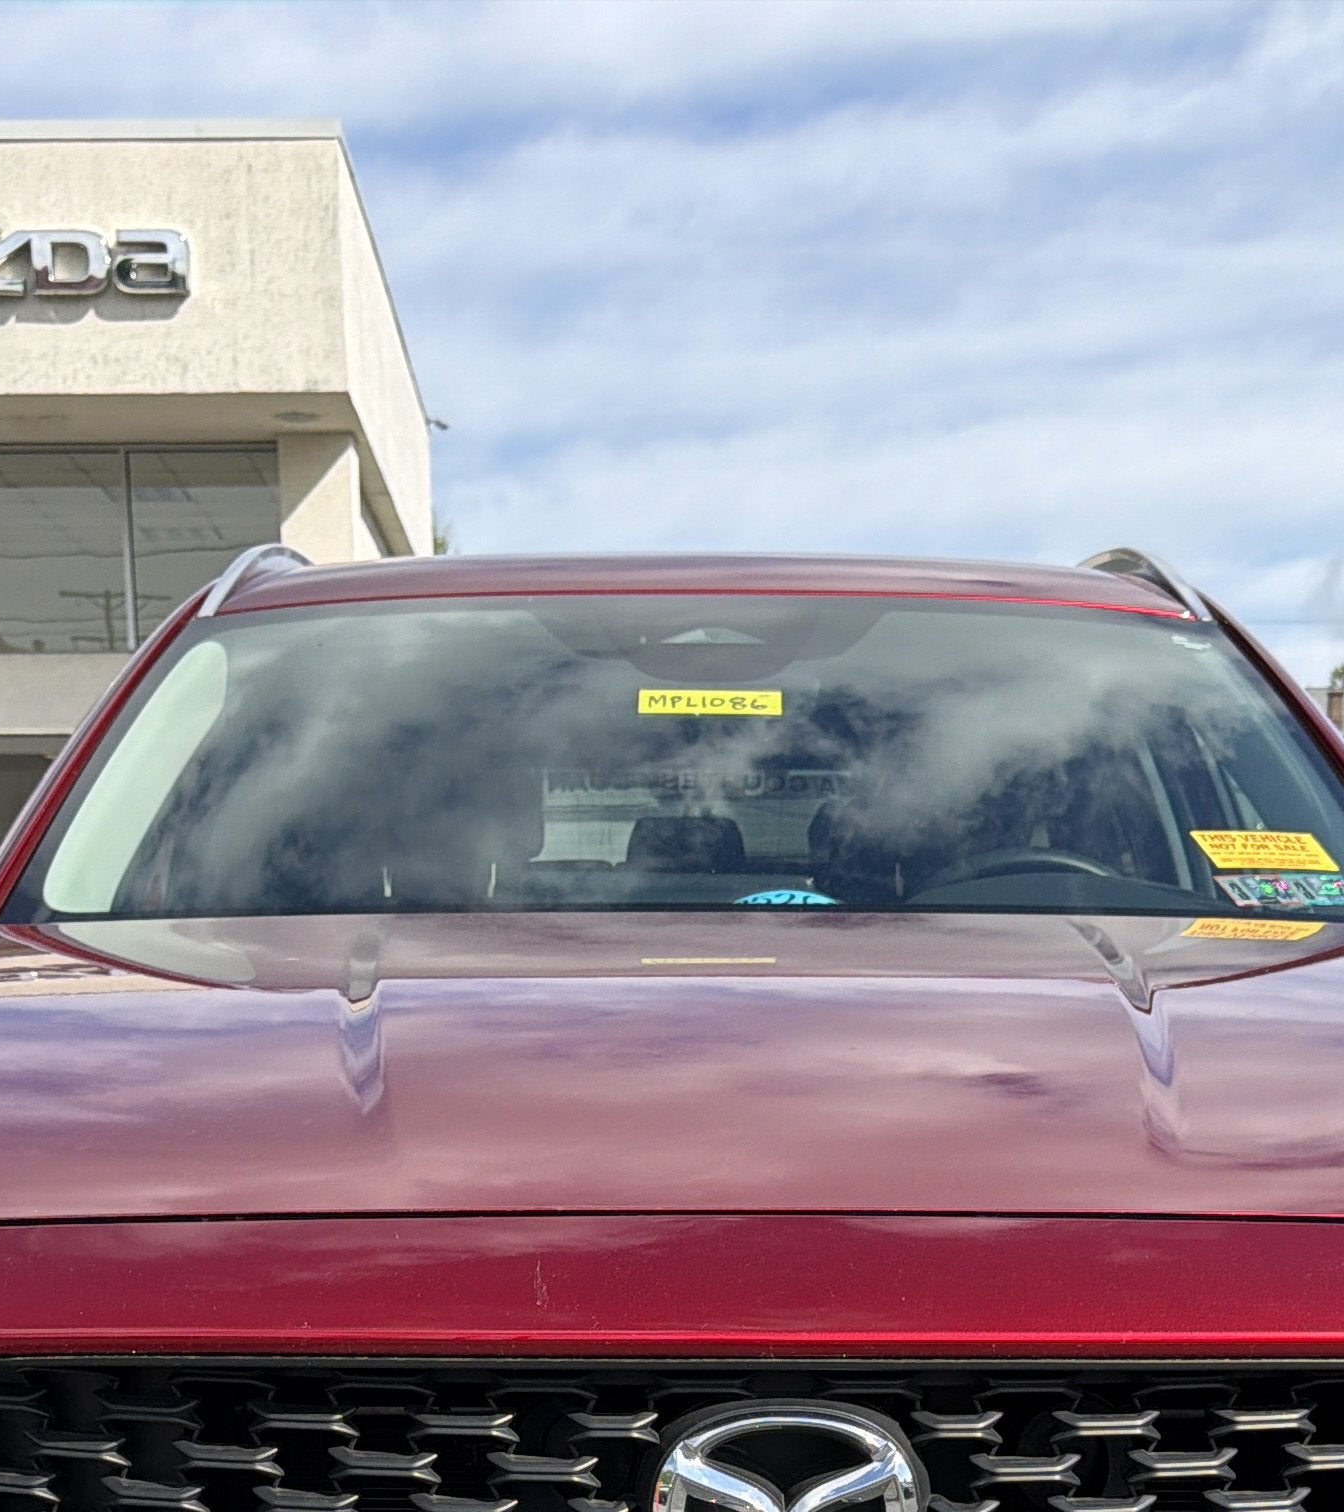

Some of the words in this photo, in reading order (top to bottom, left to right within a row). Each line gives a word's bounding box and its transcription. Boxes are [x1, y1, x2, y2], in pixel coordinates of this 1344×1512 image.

[1197, 833, 1237, 843] THIS
[1237, 834, 1308, 845] VEHICLE
[1208, 843, 1237, 851] NOT
[1240, 843, 1269, 852] FOR
[1272, 843, 1310, 852] SALE
